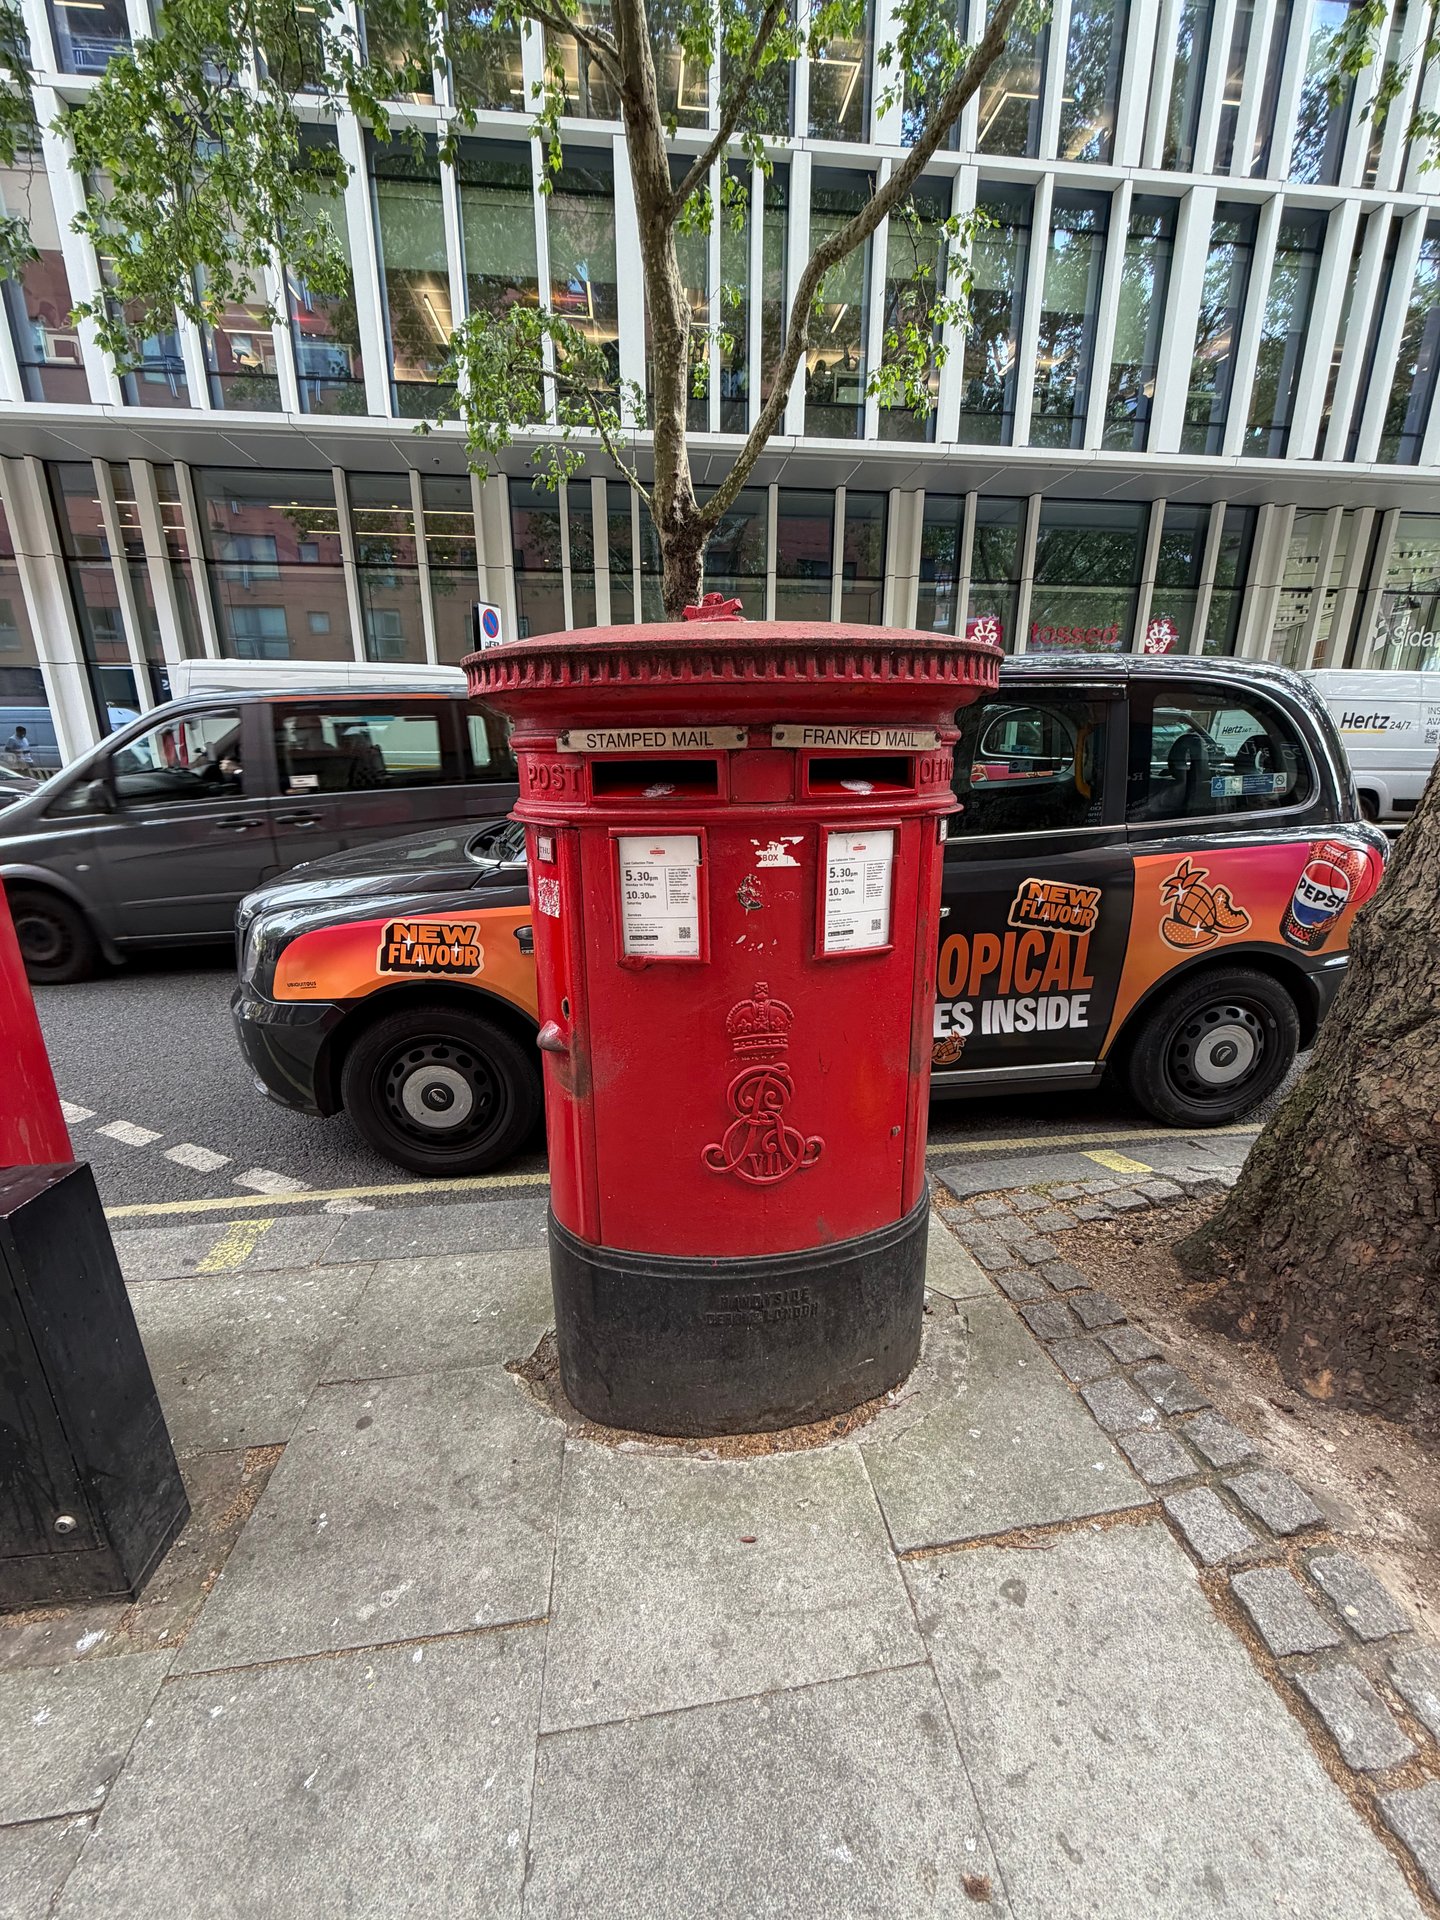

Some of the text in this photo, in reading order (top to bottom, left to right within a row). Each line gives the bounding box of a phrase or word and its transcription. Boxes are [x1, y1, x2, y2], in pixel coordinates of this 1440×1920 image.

[1030, 622, 1118, 645] tossed
[1340, 712, 1411, 731] Hertz 24/7
[586, 731, 714, 748] STAMPED MAIL
[803, 729, 918, 747] FRANKED MAIL
[528, 763, 584, 792] POST
[762, 854, 779, 862] BOX
[625, 869, 658, 882] 5.30pm
[829, 866, 858, 879] 5.30pm
[1028, 882, 1097, 908] NEW
[1298, 877, 1344, 909] PEPSI
[1019, 899, 1095, 927] FLAVOUR
[393, 924, 475, 945] NEW
[1288, 924, 1311, 941] MAX
[388, 943, 480, 967] FLAVOUR
[981, 994, 1091, 1035] INSIDE
